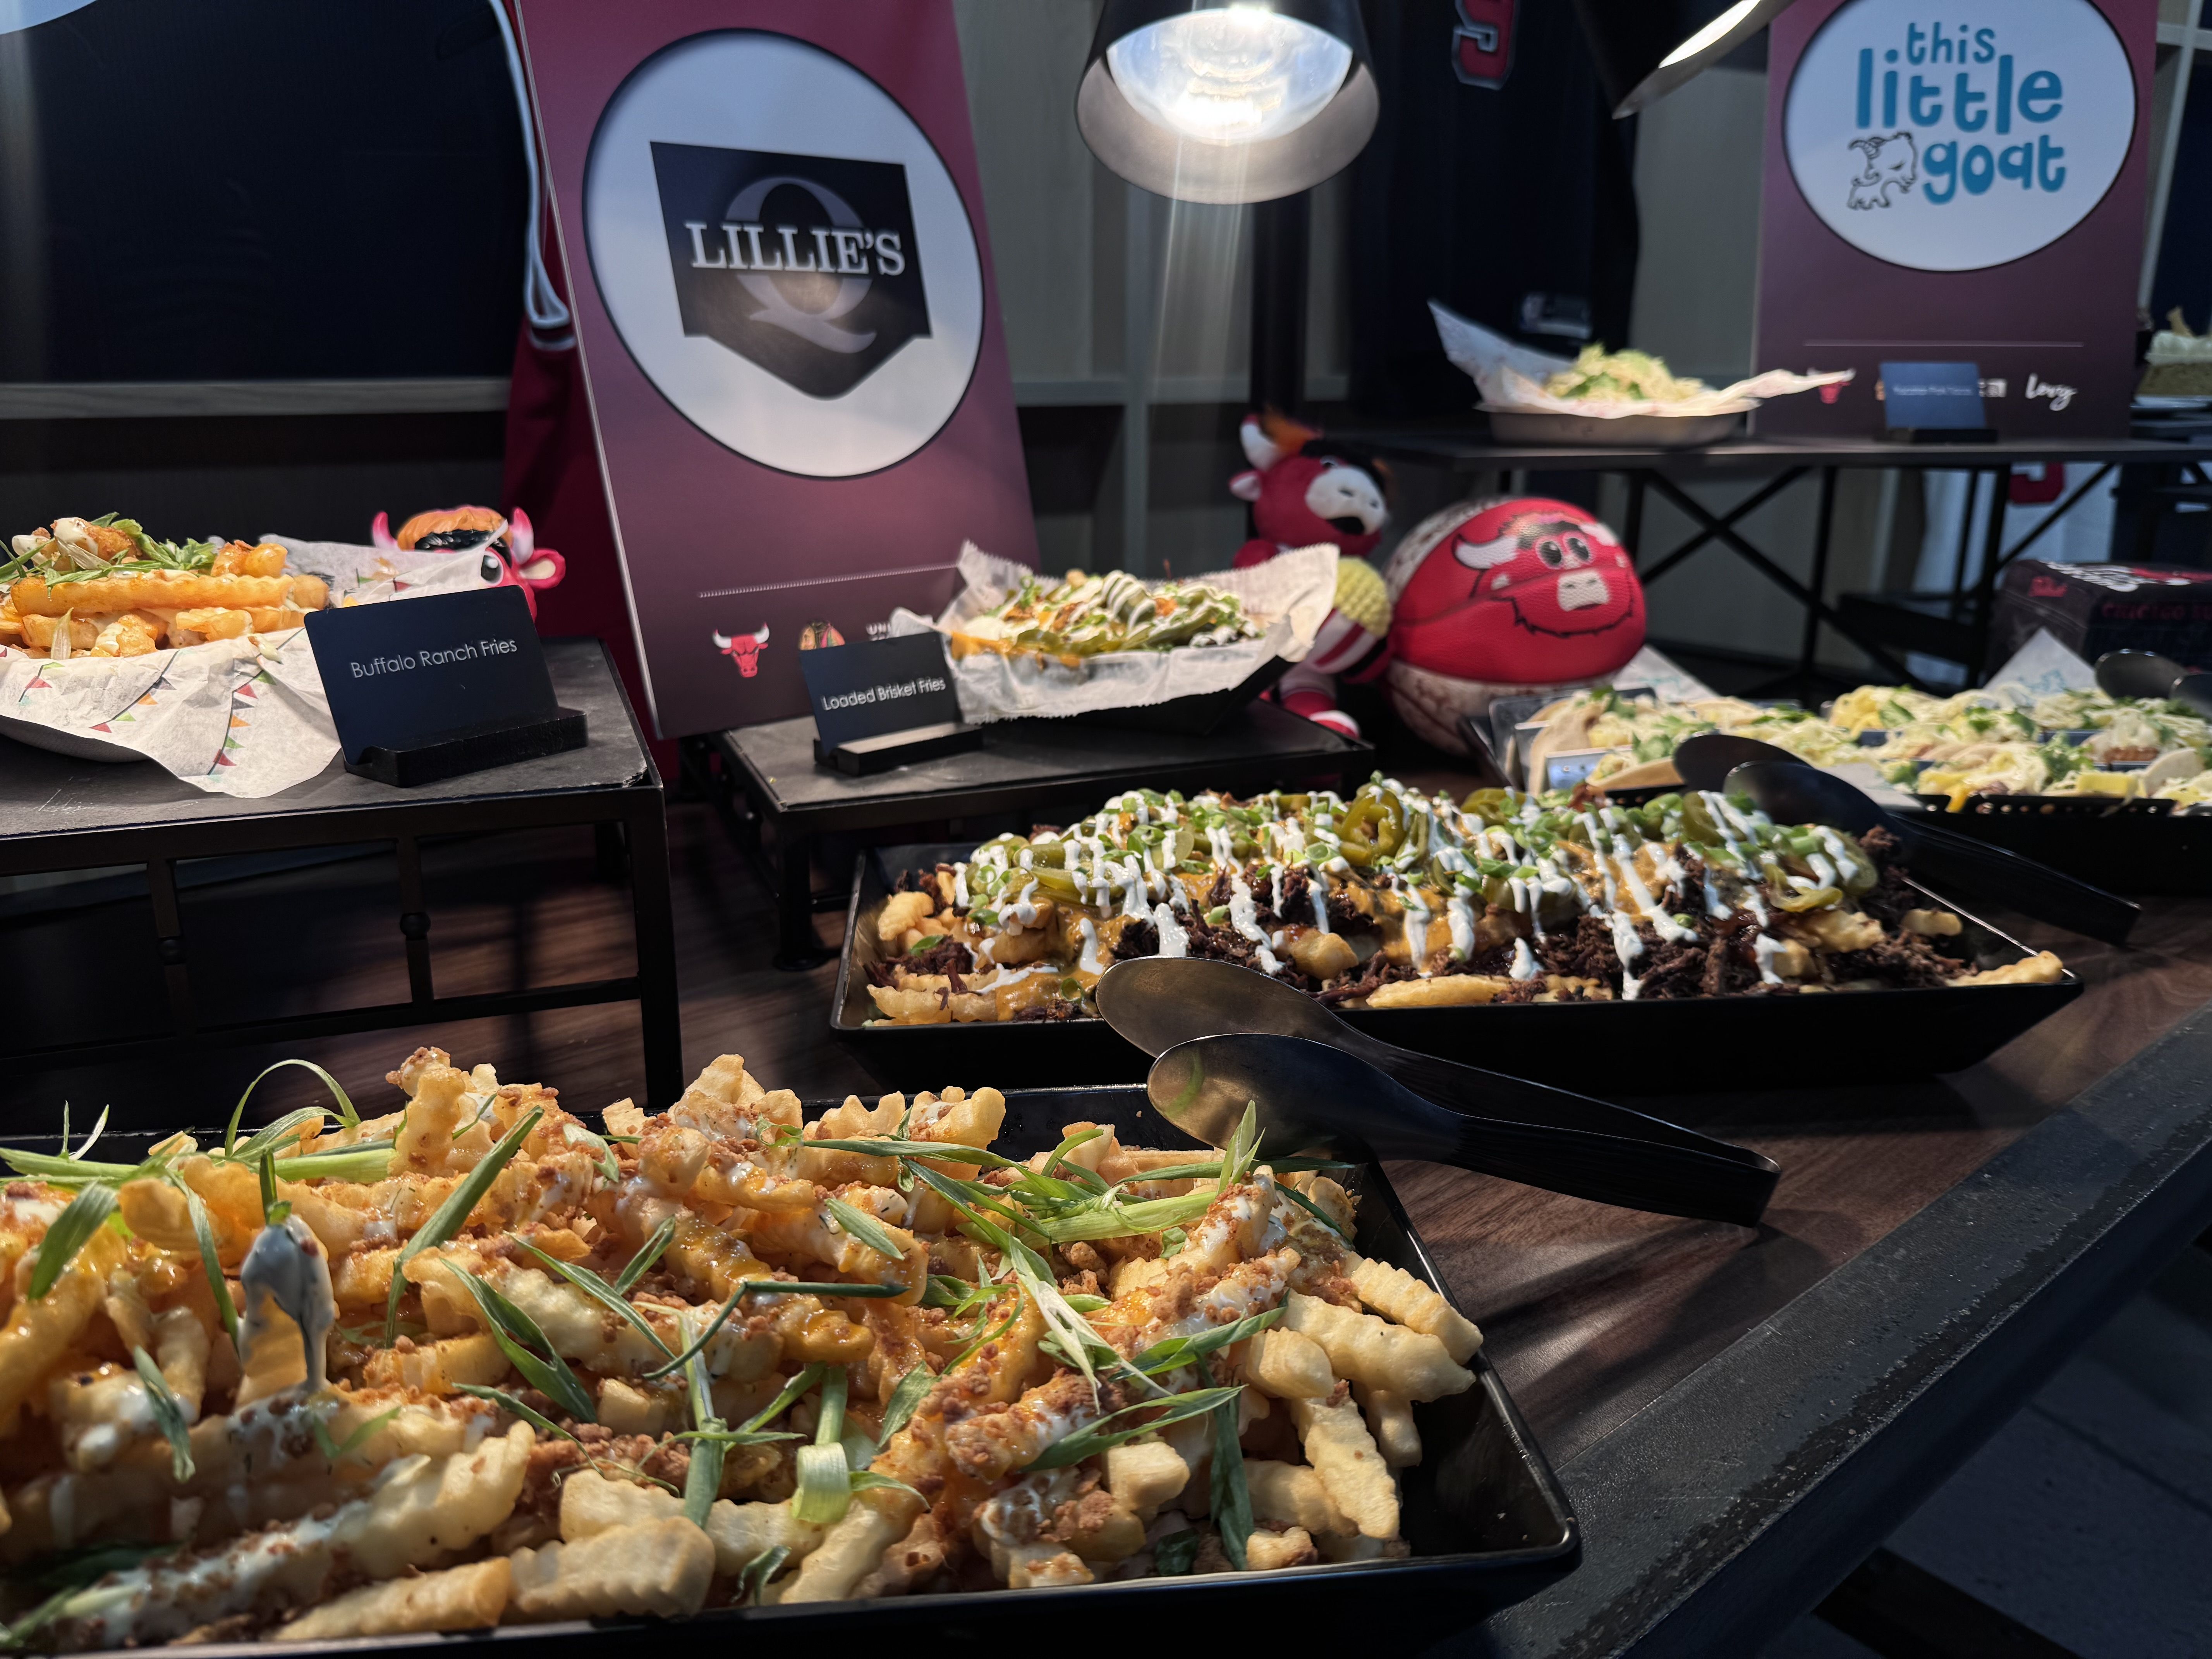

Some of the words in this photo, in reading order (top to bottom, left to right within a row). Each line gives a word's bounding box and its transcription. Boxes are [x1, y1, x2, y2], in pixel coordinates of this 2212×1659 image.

[1906, 21, 1996, 65] this
[1855, 48, 2063, 135] little
[1922, 134, 2066, 206] goat
[684, 221, 905, 276] LILLIE'S
[726, 177, 876, 353] Q
[350, 654, 416, 678] Buffalo
[419, 643, 478, 667] Ranch
[480, 638, 518, 658] Fries
[823, 688, 876, 711] Loaded
[877, 679, 917, 701] Brisket
[918, 677, 946, 694] Fries
